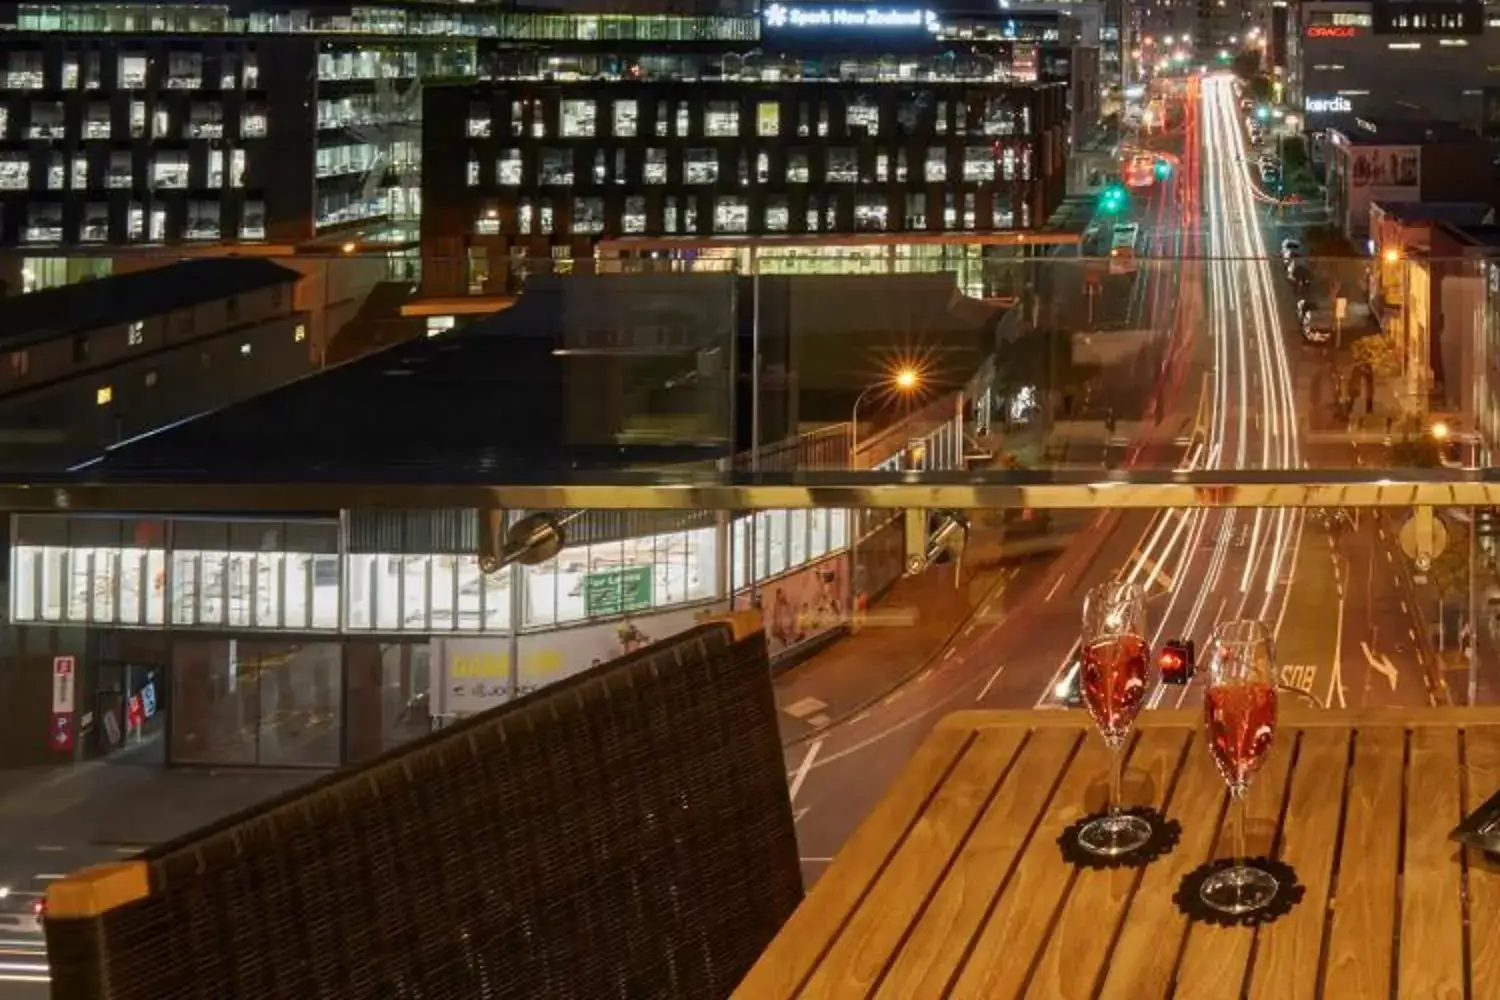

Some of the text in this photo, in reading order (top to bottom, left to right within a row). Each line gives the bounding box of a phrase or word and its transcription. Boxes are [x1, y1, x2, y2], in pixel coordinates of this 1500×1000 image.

[789, 8, 921, 26] Spark New Zealand
[1307, 27, 1355, 38] ORACLE
[1305, 95, 1352, 112] kordia
